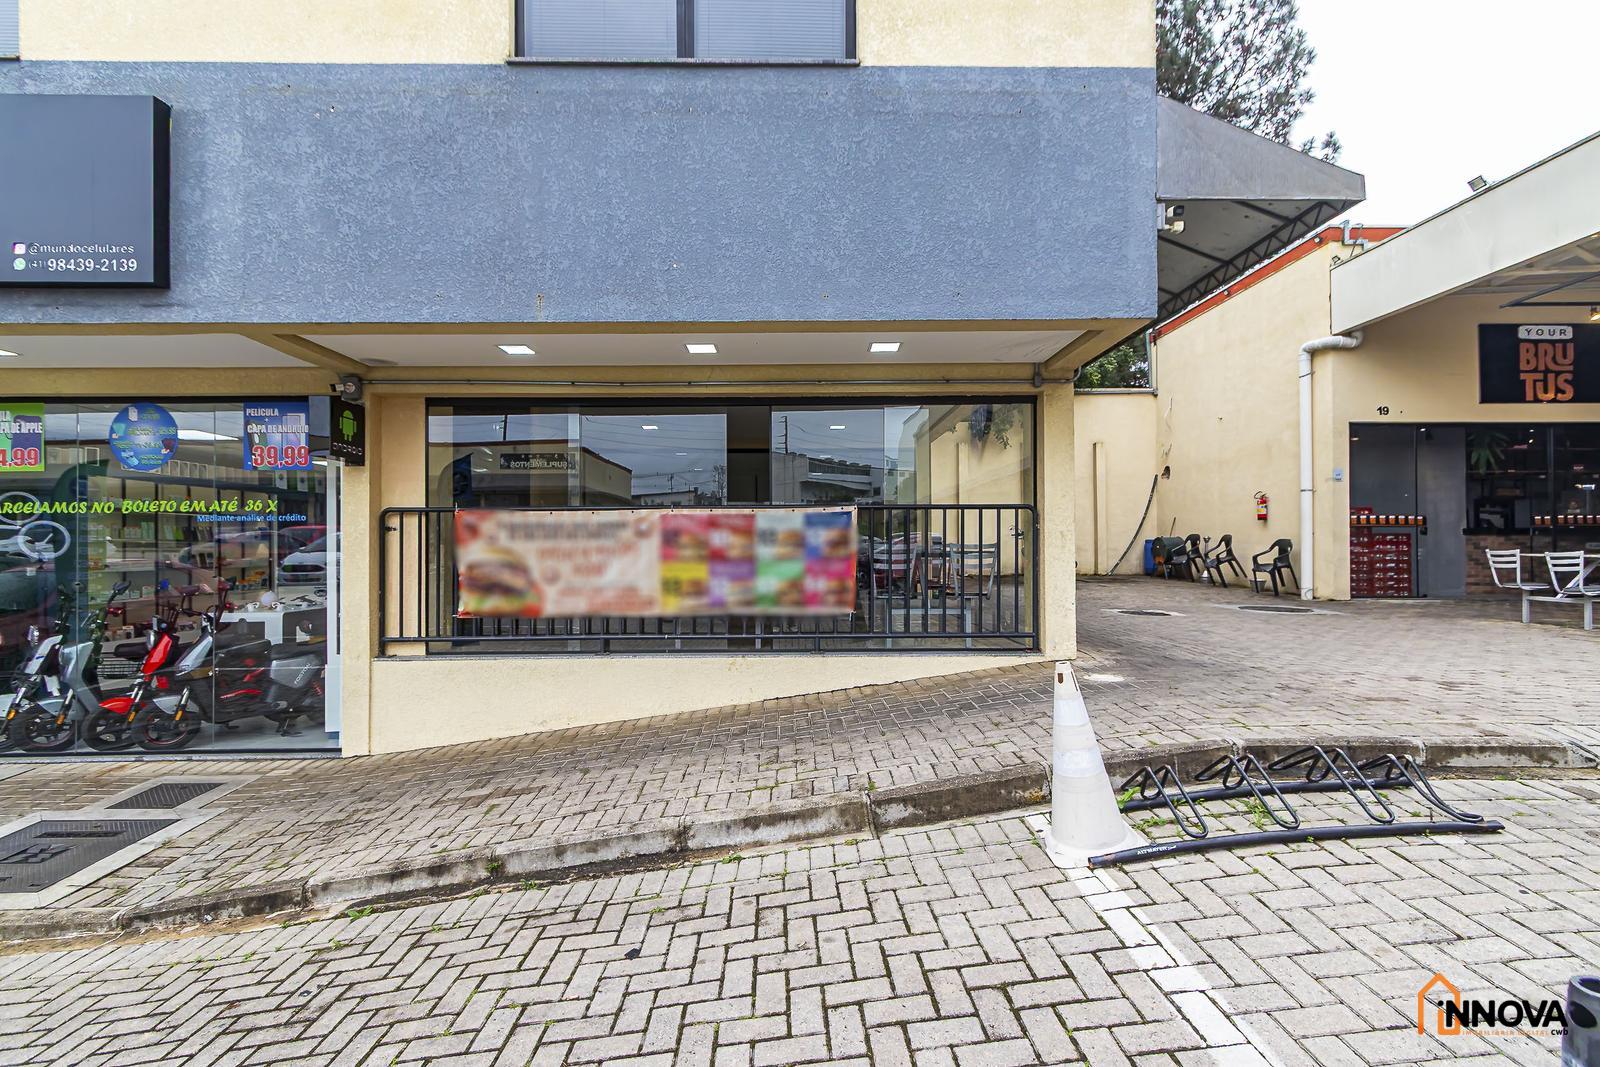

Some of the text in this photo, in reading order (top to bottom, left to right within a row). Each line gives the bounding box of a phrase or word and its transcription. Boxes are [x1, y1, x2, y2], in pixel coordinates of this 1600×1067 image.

[29, 243, 135, 255] @mundocelulares
[47, 258, 138, 272] 98439-2139
[1525, 328, 1568, 337] YOUR
[1376, 406, 1390, 416] 19
[21, 422, 43, 433] APPLE
[247, 424, 267, 434] CAPA
[252, 444, 309, 468] 39,99
[90, 501, 115, 514] NO
[121, 500, 177, 513] BOLETO
[180, 500, 206, 512] EM
[208, 496, 239, 512] ATÉ
[244, 500, 263, 512] 36
[265, 499, 278, 513] X
[197, 514, 236, 522] Mediante
[236, 514, 265, 522] análise
[278, 513, 307, 522] crédito
